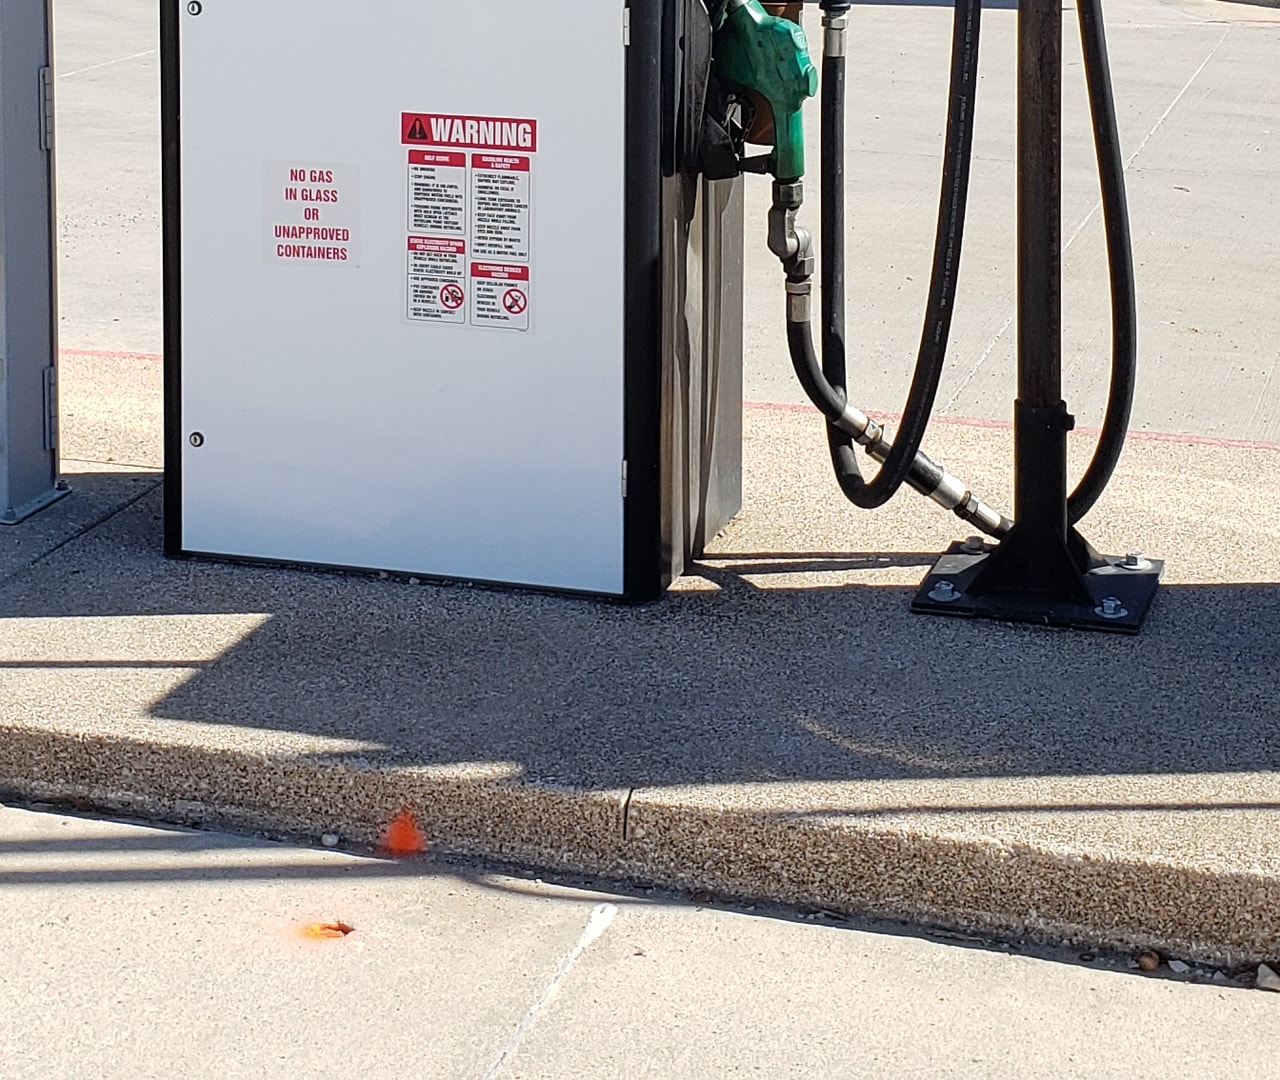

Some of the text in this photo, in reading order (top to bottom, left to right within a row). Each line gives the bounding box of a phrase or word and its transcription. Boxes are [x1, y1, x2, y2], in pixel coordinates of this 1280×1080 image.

[430, 117, 532, 148] WARNING
[290, 168, 333, 183] NO GAS
[285, 187, 338, 203] IN GLASS
[304, 208, 319, 221] OR
[274, 225, 349, 242] UNAPPROVED
[277, 244, 348, 261] CONTAINERS
